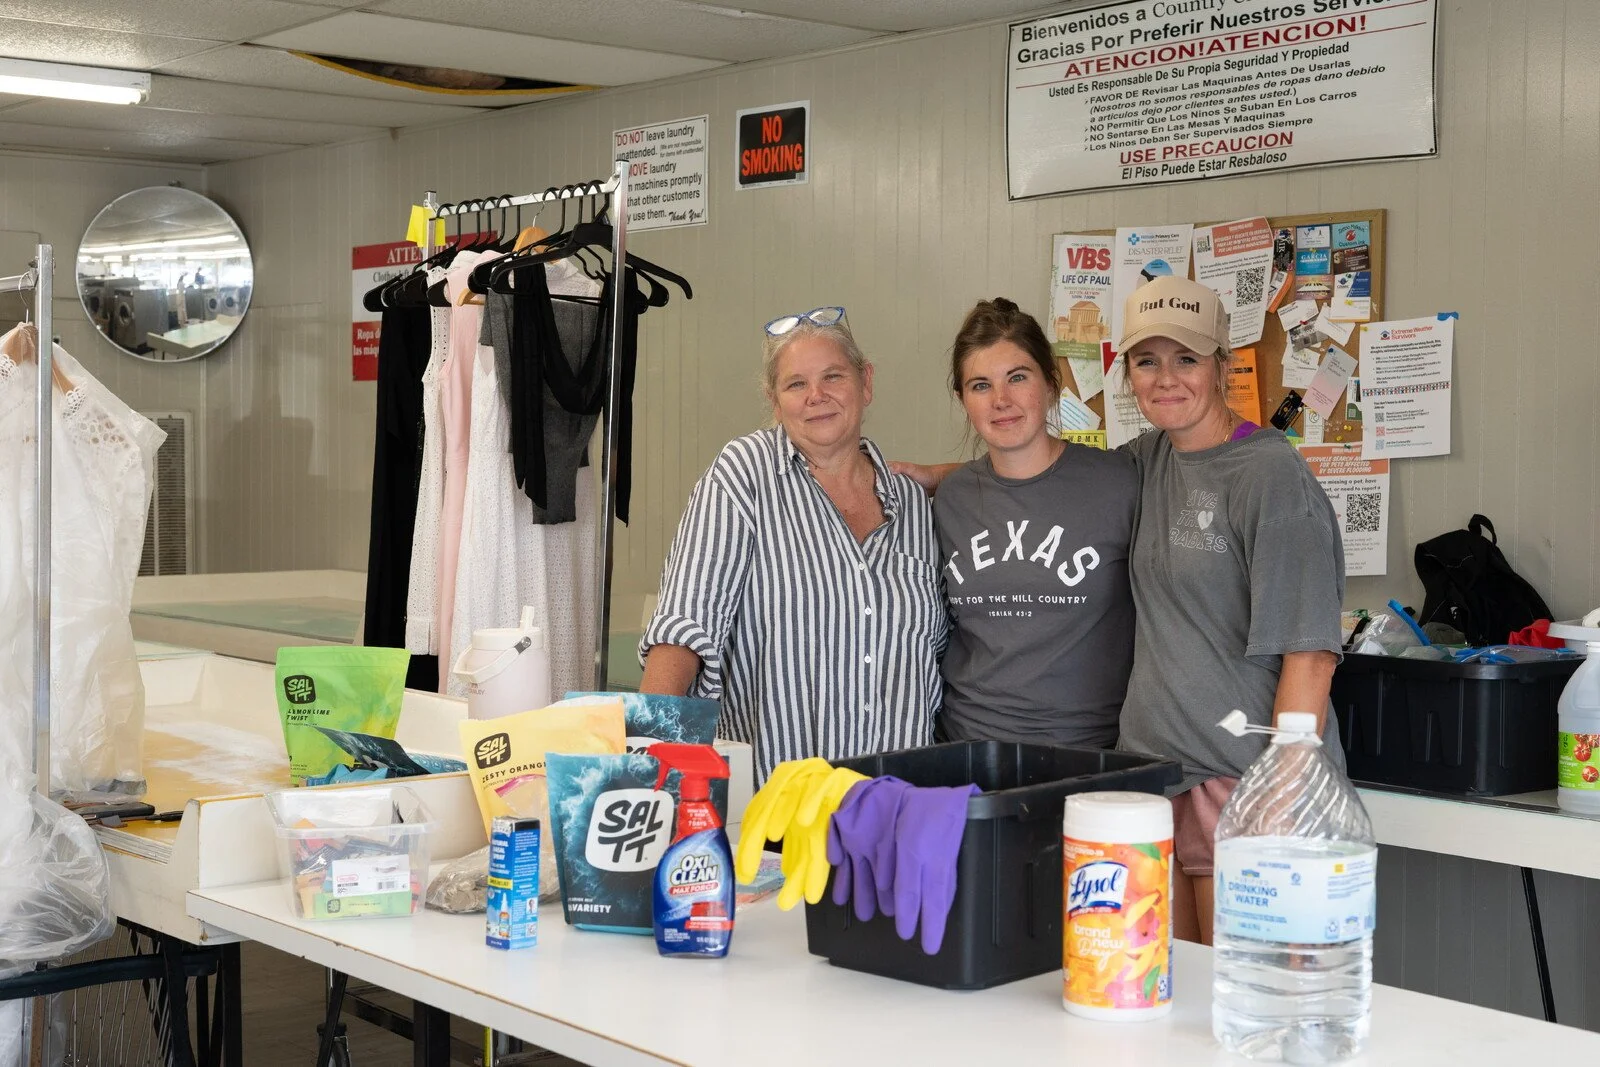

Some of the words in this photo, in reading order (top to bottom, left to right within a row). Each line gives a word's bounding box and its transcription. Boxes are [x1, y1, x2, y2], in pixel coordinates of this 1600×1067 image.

[1017, 41, 1085, 63] Gracias
[1091, 34, 1124, 51] Por
[1130, 20, 1204, 44] Preferir
[1210, 3, 1306, 31] Nuestros
[1022, 12, 1129, 42] Bienvenidos
[1136, 9, 1146, 21] a
[1049, 85, 1075, 98] Usted
[1077, 83, 1089, 93] Es
[1092, 71, 1153, 91] Responsable
[1156, 69, 1169, 80] De
[1172, 66, 1185, 78] Su
[1187, 61, 1221, 79] Propia
[1224, 53, 1278, 72] Seguridad
[1281, 51, 1289, 61] Y
[1292, 41, 1350, 61] Propiedad
[1090, 92, 1123, 104] FAVOR
[1126, 90, 1139, 99] DE
[1142, 85, 1179, 97] Revisar
[1182, 81, 1200, 91] Las
[1203, 73, 1253, 88] Maquinas
[1256, 68, 1287, 80] Antes
[1290, 66, 1306, 75] De
[1308, 59, 1351, 72] Usarlas
[1090, 102, 1136, 116] (Nosotros
[1139, 98, 1151, 106] no
[1154, 94, 1187, 105] somos
[1190, 82, 1260, 101] responsables
[1264, 78, 1277, 89] de
[1280, 75, 1311, 88] ropas
[1314, 70, 1343, 82] dano
[1346, 64, 1386, 78] debido
[1090, 124, 1105, 133] NO
[1107, 118, 1144, 131] Permitir
[1147, 116, 1167, 126] Que
[1170, 112, 1188, 122] Los
[1191, 108, 1220, 120] Ninos
[1223, 106, 1237, 115] Se
[1240, 101, 1274, 113] Suban
[1278, 98, 1292, 108] En
[1295, 95, 1316, 106] Los
[1319, 90, 1357, 103] Carros
[1098, 109, 1139, 123] articulos
[1141, 105, 1162, 117] dejo
[1165, 104, 1183, 115] por
[1185, 98, 1225, 111] clientes
[1227, 93, 1256, 104] antes
[1259, 87, 1297, 99] usted.)
[616, 133, 628, 147] DO
[629, 130, 645, 144] NOT
[646, 128, 666, 142] leave
[667, 124, 695, 139] laundry
[762, 115, 782, 144] NO
[1089, 143, 1107, 152] Los
[1109, 139, 1137, 149] Ninos
[1139, 135, 1170, 145] Deban
[1173, 132, 1191, 141] Ser
[1193, 122, 1264, 139] Supervisados
[1268, 116, 1313, 130] Siempre
[1090, 133, 1104, 142] NO
[1107, 128, 1149, 140] Sentarse
[1151, 126, 1165, 134] En
[1167, 122, 1185, 132] Las
[1188, 118, 1220, 130] Mesas
[1224, 116, 1231, 125] Y
[1233, 110, 1285, 124] Maquinas
[616, 146, 658, 161] unattended.
[1120, 148, 1156, 164] USE
[1162, 131, 1294, 160] PRECAUCION
[649, 161, 677, 173] laundry
[742, 143, 803, 177] SMOKING
[1121, 168, 1133, 180] El
[1135, 164, 1158, 179] Piso
[1161, 160, 1195, 176] Puede
[1198, 158, 1227, 172] Estar
[1229, 151, 1287, 168] Resbaloso
[634, 179, 668, 193] machines
[670, 172, 702, 189] promptly
[642, 193, 660, 206] other
[662, 189, 700, 204] customers
[633, 211, 646, 221] use
[647, 208, 667, 221] them.
[669, 210, 686, 222] Thank
[688, 209, 704, 221] You!
[1067, 247, 1111, 271] VBS
[1128, 246, 1163, 256] DISASTER
[1062, 274, 1076, 284] LIFE
[1078, 275, 1088, 284] OF
[1090, 276, 1111, 285] PAUL
[1139, 297, 1165, 314] But
[1168, 297, 1200, 314] God
[945, 520, 1100, 587] TEXAS
[966, 596, 984, 604] FOR
[988, 595, 1006, 603] THE
[1012, 594, 1034, 603] HILL
[1038, 595, 1088, 604] COUNTRY
[287, 678, 312, 690] SAL
[477, 736, 508, 756] SAL
[482, 770, 506, 784] ZESTY
[598, 800, 664, 834] SAL
[598, 828, 656, 863] TT
[682, 854, 709, 870] OXI
[670, 868, 718, 886] CLEAN
[1070, 867, 1122, 907] Lysol
[672, 886, 690, 894] MAX
[690, 884, 716, 893] FORCE
[1228, 882, 1278, 897] DRINKING
[572, 903, 612, 914] VARIETY
[1235, 894, 1268, 908] WATER
[1074, 924, 1112, 938] brand
[1092, 938, 1124, 949] new
